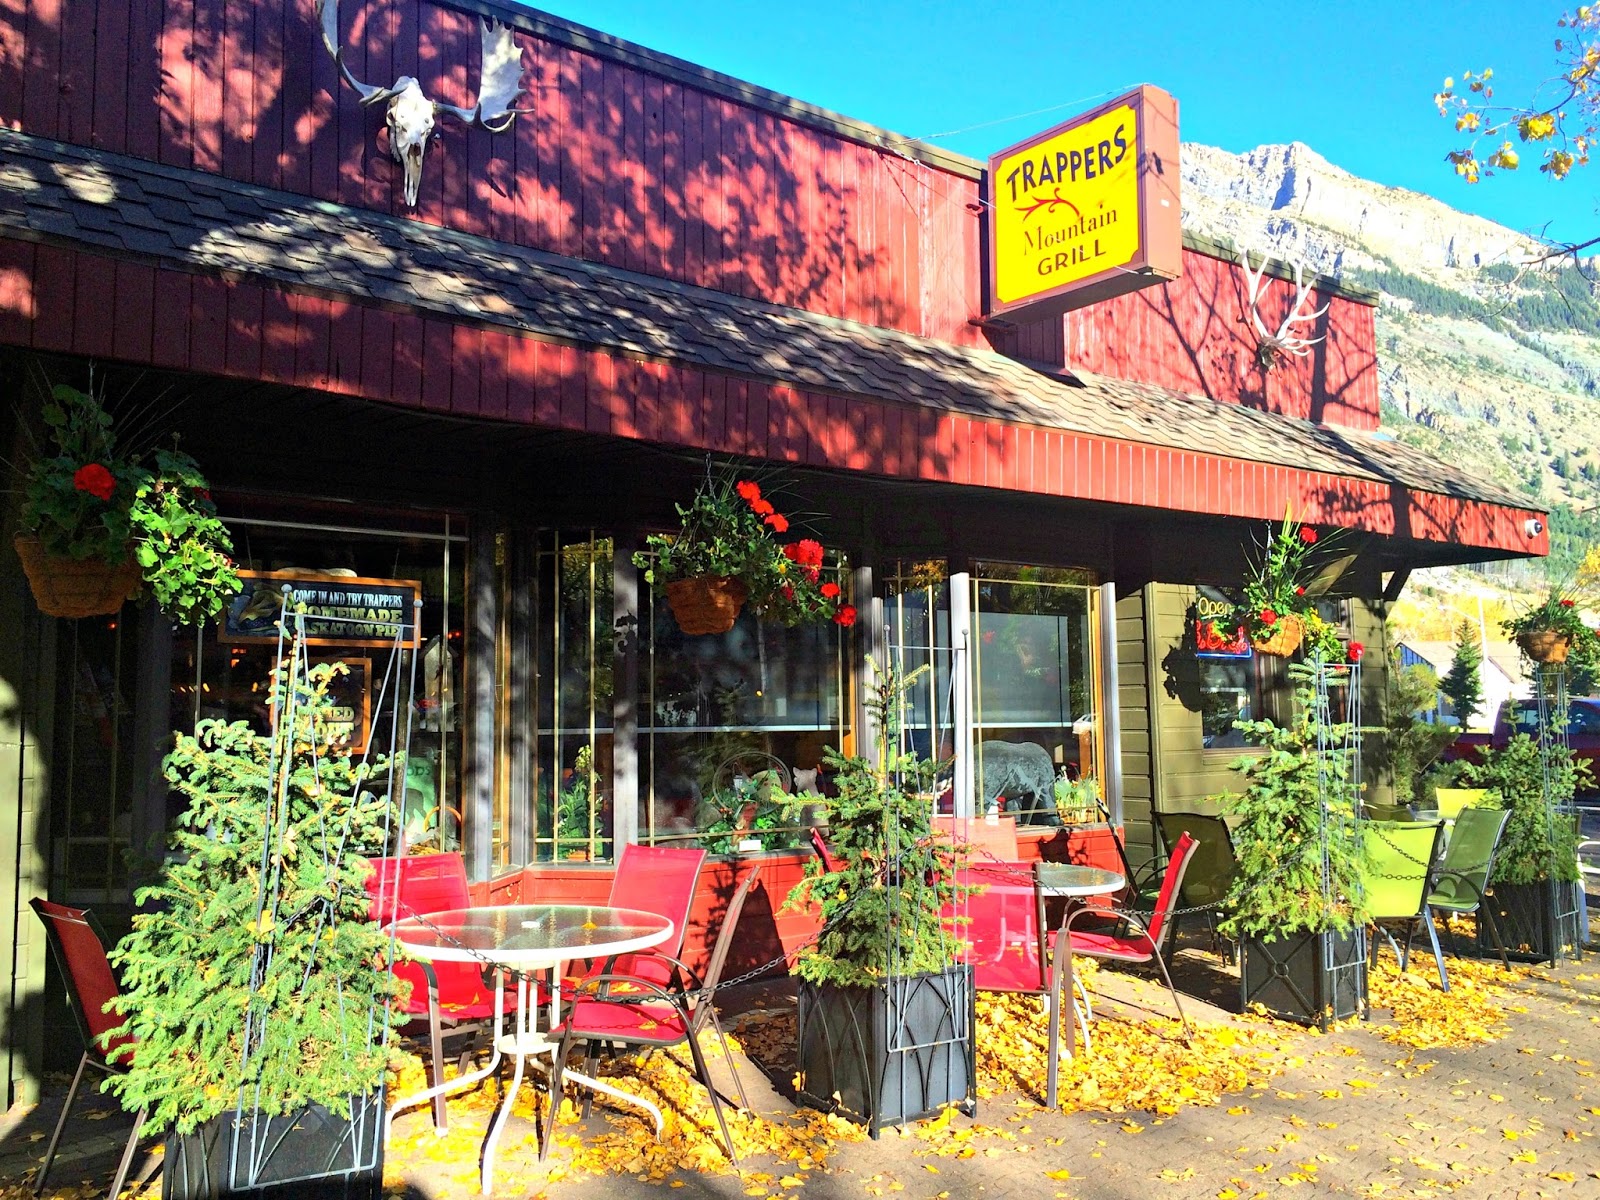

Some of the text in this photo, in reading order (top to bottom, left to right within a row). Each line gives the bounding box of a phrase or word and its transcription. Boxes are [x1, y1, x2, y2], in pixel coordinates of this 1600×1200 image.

[1006, 123, 1127, 203] TRAPPERS
[1024, 203, 1118, 256] Mountain
[1037, 239, 1107, 276] GRILL
[293, 589, 403, 608] COME IN AND TRY TRAPPERS
[306, 605, 403, 624] OMEMADE
[305, 621, 399, 638] ASKATOON PIE
